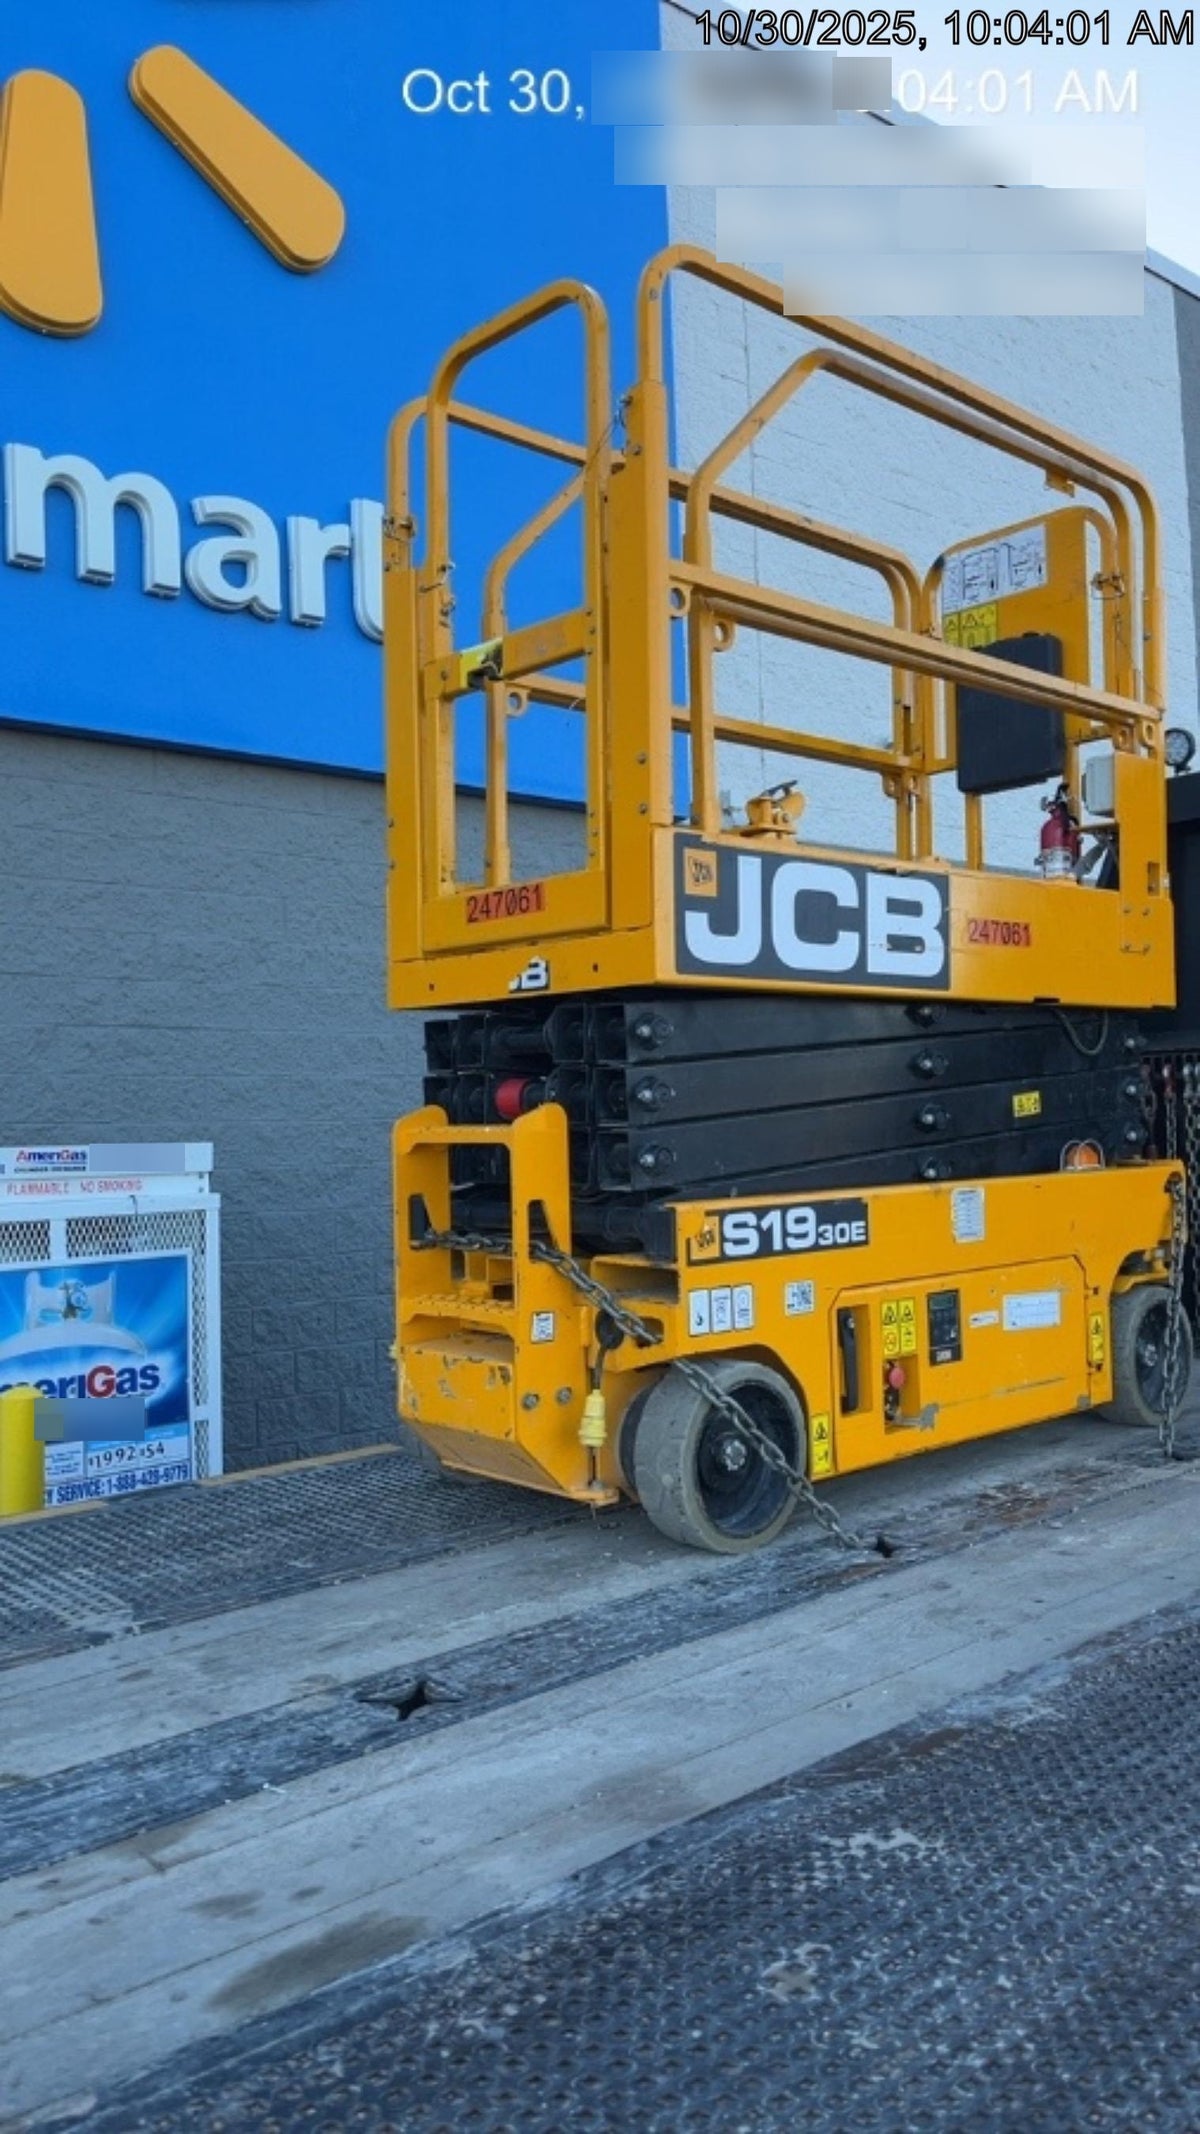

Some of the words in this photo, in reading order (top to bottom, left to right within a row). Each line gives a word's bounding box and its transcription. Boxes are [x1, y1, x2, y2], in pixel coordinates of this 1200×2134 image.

[466, 883, 543, 923] 247061
[685, 855, 945, 978] JCB
[967, 918, 1030, 947] 247061
[16, 1149, 87, 1162] AmeriGas
[722, 1206, 817, 1257] S19
[818, 1221, 867, 1246] 30E
